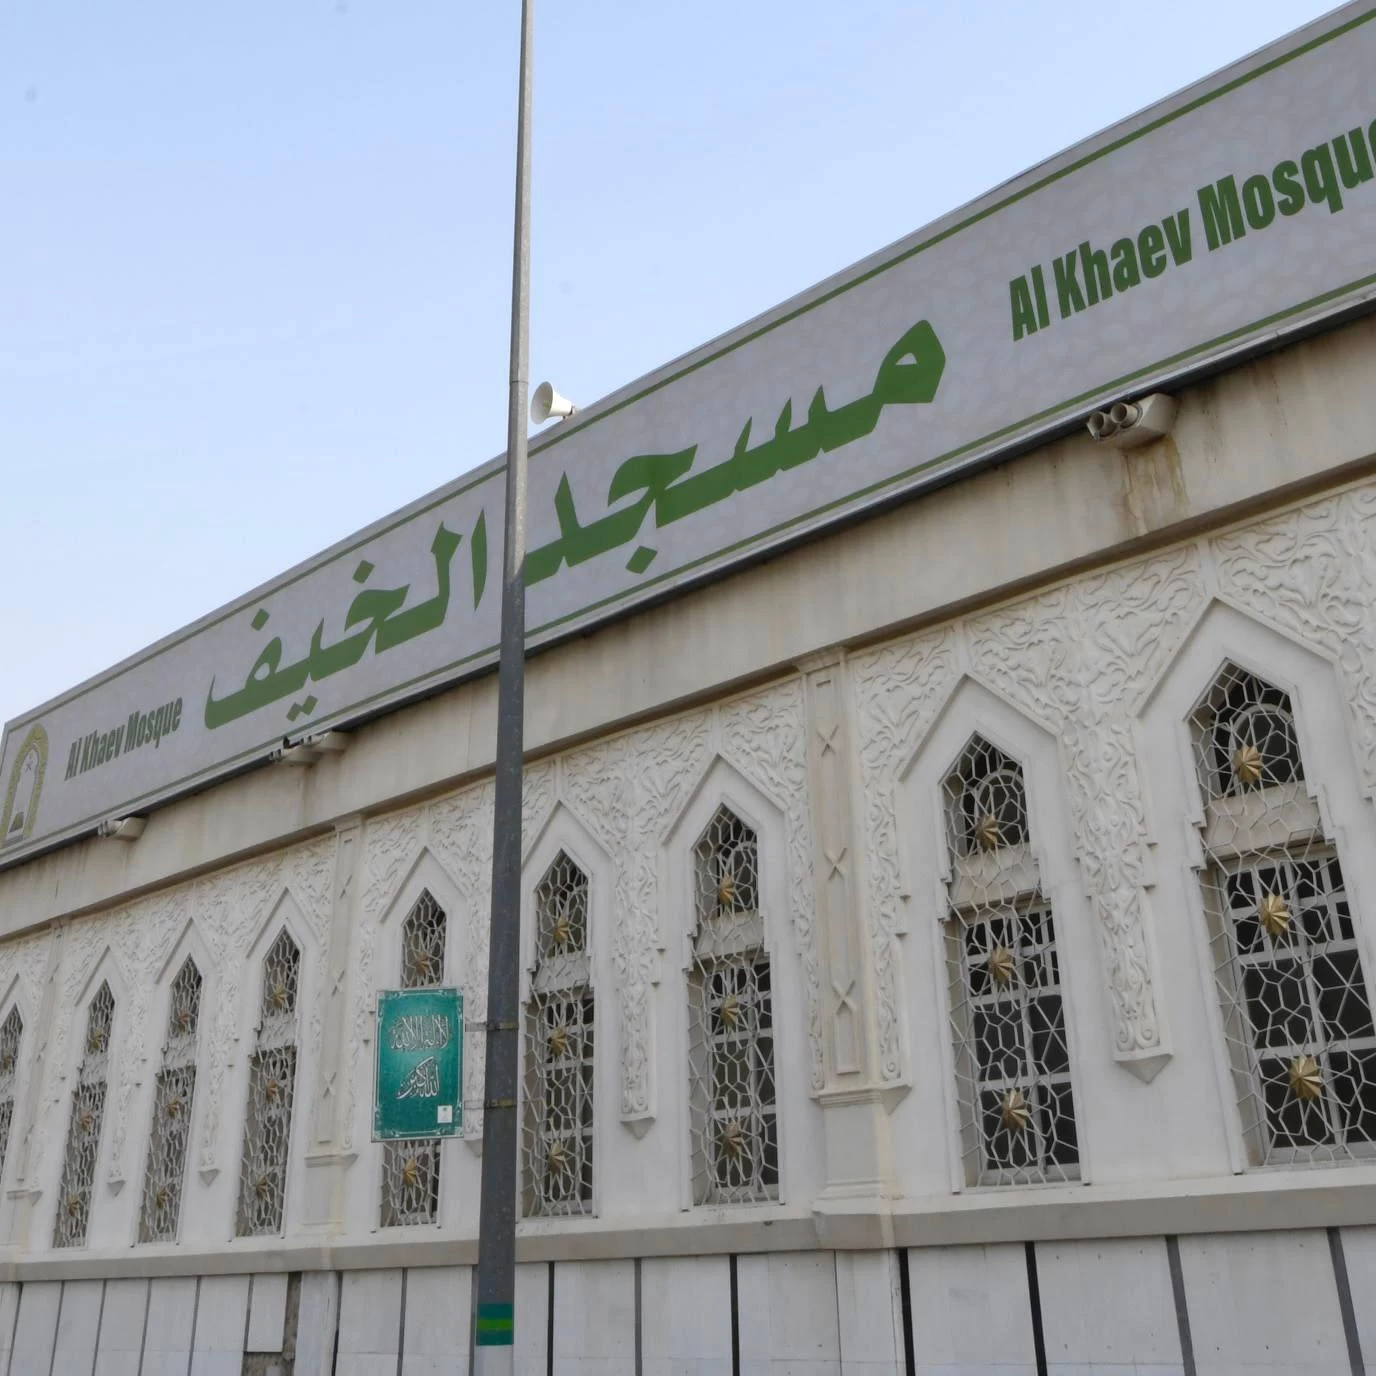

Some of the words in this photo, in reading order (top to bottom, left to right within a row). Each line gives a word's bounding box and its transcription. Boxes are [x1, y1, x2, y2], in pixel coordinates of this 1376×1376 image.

[1009, 264, 1051, 342] Al
[1052, 208, 1193, 320] Khaev
[524, 319, 947, 587] مسجد
[204, 508, 488, 730] الخيف
[64, 737, 82, 782] Al
[79, 724, 126, 775] Khaev
[124, 696, 183, 755] Mosque
